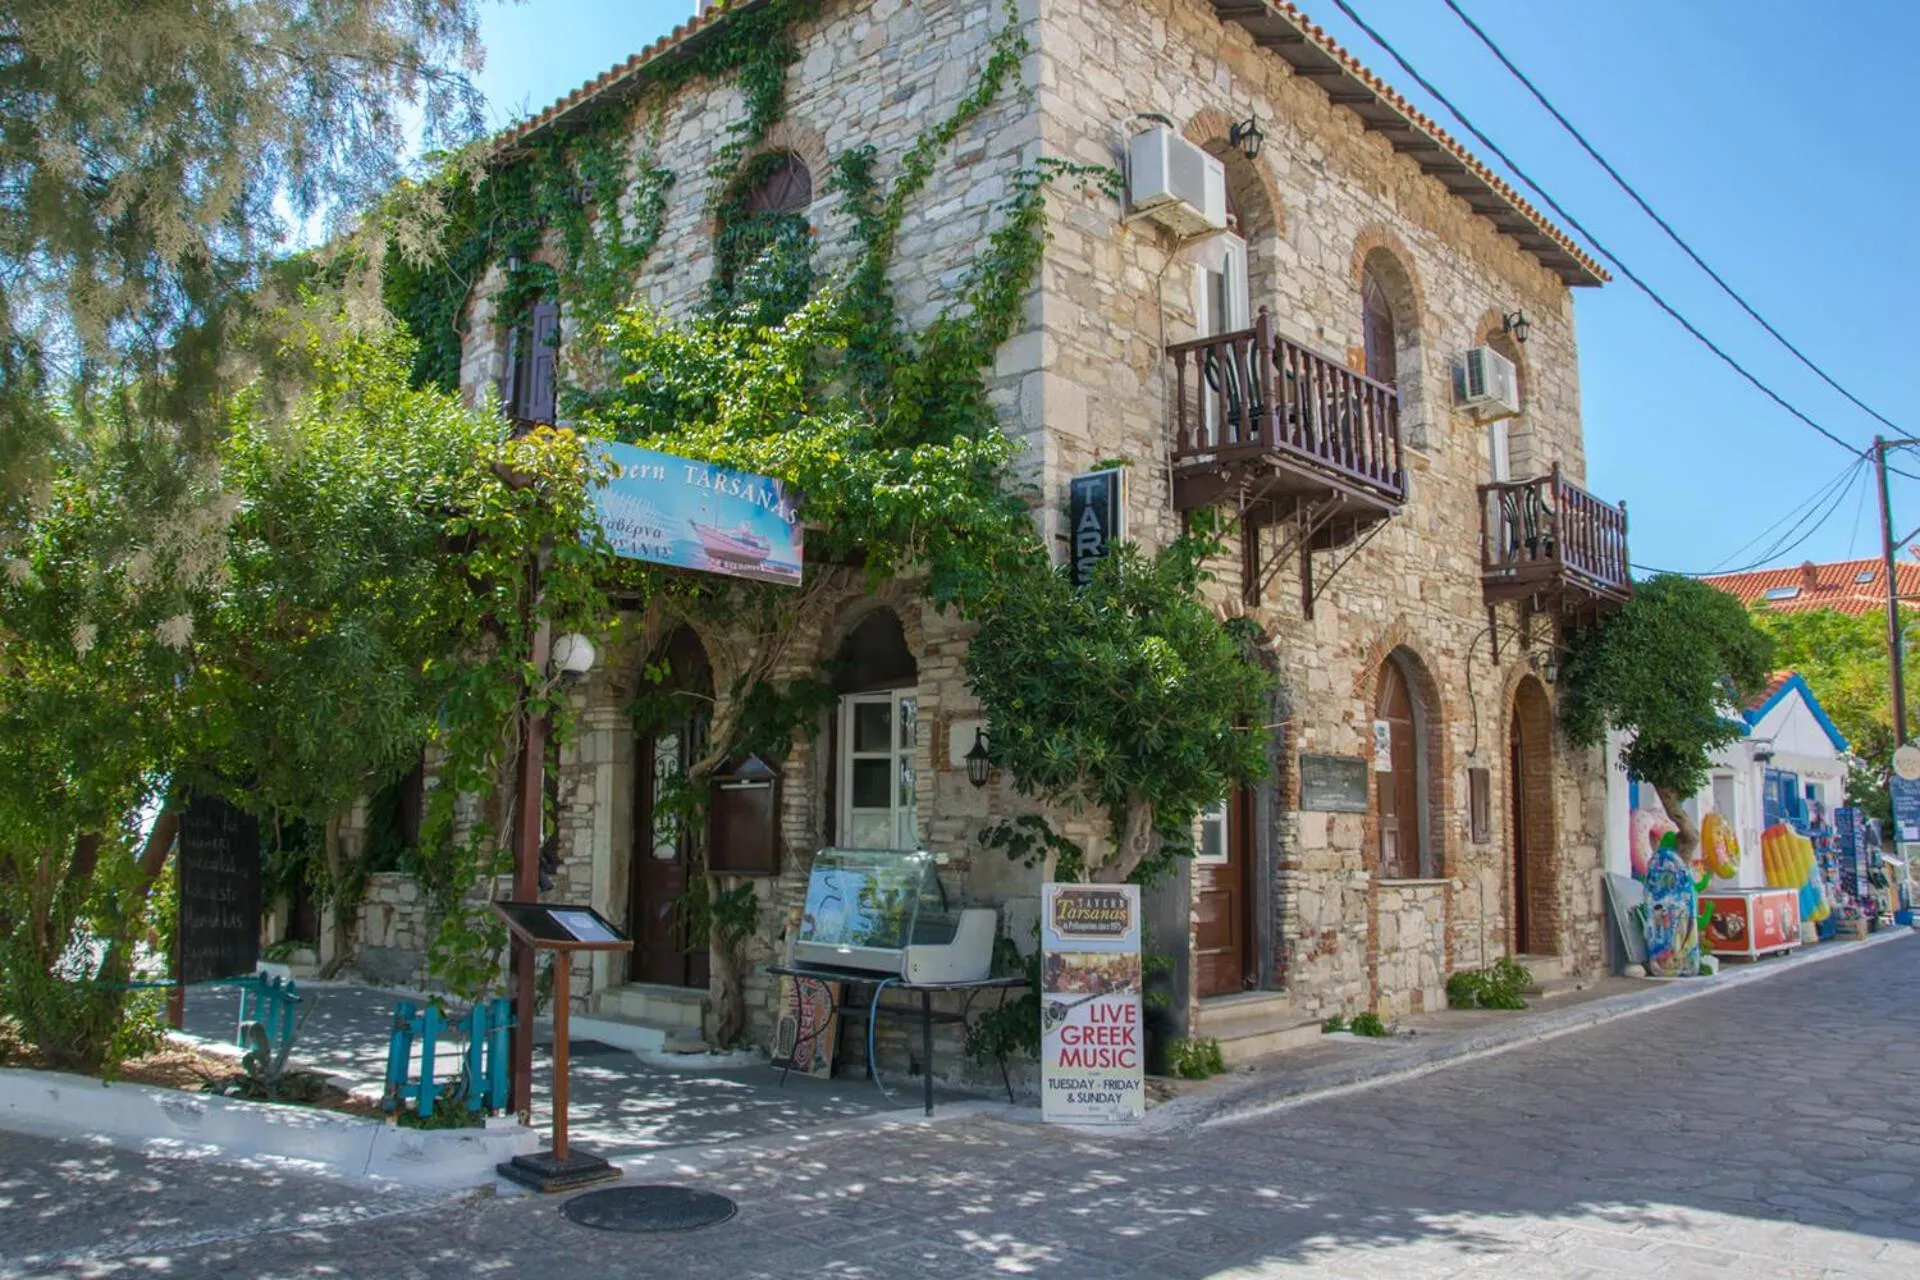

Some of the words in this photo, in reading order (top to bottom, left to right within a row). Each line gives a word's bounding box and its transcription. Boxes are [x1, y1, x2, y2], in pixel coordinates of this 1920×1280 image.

[684, 464, 798, 525] TARSANAS
[1056, 899, 1127, 921] Tarsanas
[1090, 1003, 1136, 1023] LIVE
[1060, 1025, 1136, 1046] GREEK
[1059, 1047, 1137, 1069] MUSIC
[1048, 1078, 1095, 1090] TUESDAY
[1103, 1079, 1141, 1090] FRIDAY
[1066, 1092, 1075, 1103] &
[1077, 1092, 1123, 1104] SUNDAY
